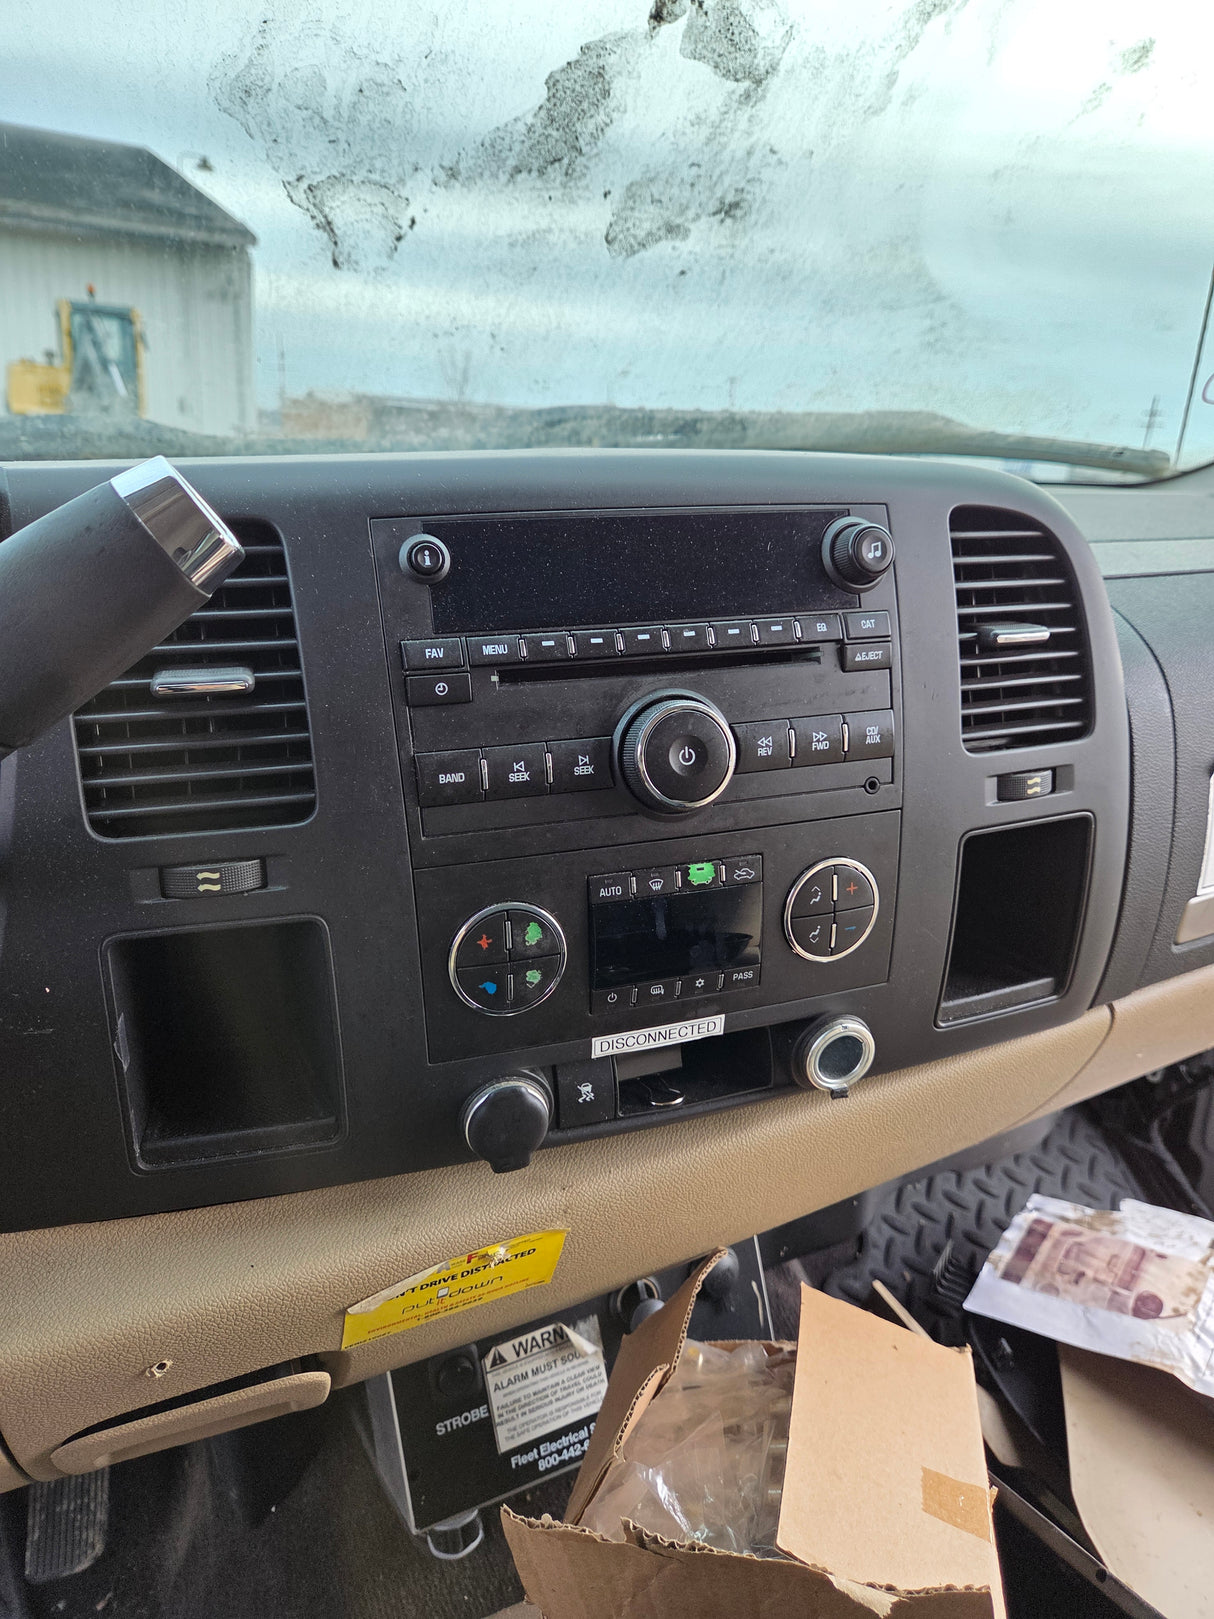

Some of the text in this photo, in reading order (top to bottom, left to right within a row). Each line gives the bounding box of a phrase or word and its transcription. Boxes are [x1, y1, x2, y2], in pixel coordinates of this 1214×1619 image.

[816, 623, 828, 632] EQ
[860, 619, 876, 630] CAT
[425, 648, 445, 660] FAV
[482, 644, 508, 656] MENU
[861, 650, 884, 660] EJECT
[812, 740, 830, 751] FWD
[865, 734, 881, 745] AUX
[757, 747, 773, 757] REV
[574, 765, 594, 776] SEEK
[438, 772, 466, 784] BAND
[508, 771, 530, 783] SEEK
[599, 886, 622, 897] AUTO
[732, 970, 754, 982] PASS
[600, 1020, 717, 1053] DISCONNECTED
[420, 1274, 458, 1291] DRIVE
[402, 1297, 434, 1314] put
[449, 1276, 504, 1298] down
[512, 1326, 568, 1358] WARN
[493, 1373, 529, 1392] ALARM
[532, 1362, 559, 1378] MUST
[560, 1350, 583, 1365] SOU
[436, 1404, 490, 1436] STROBE
[511, 1448, 538, 1469] Fleet
[540, 1426, 589, 1456] Electrical
